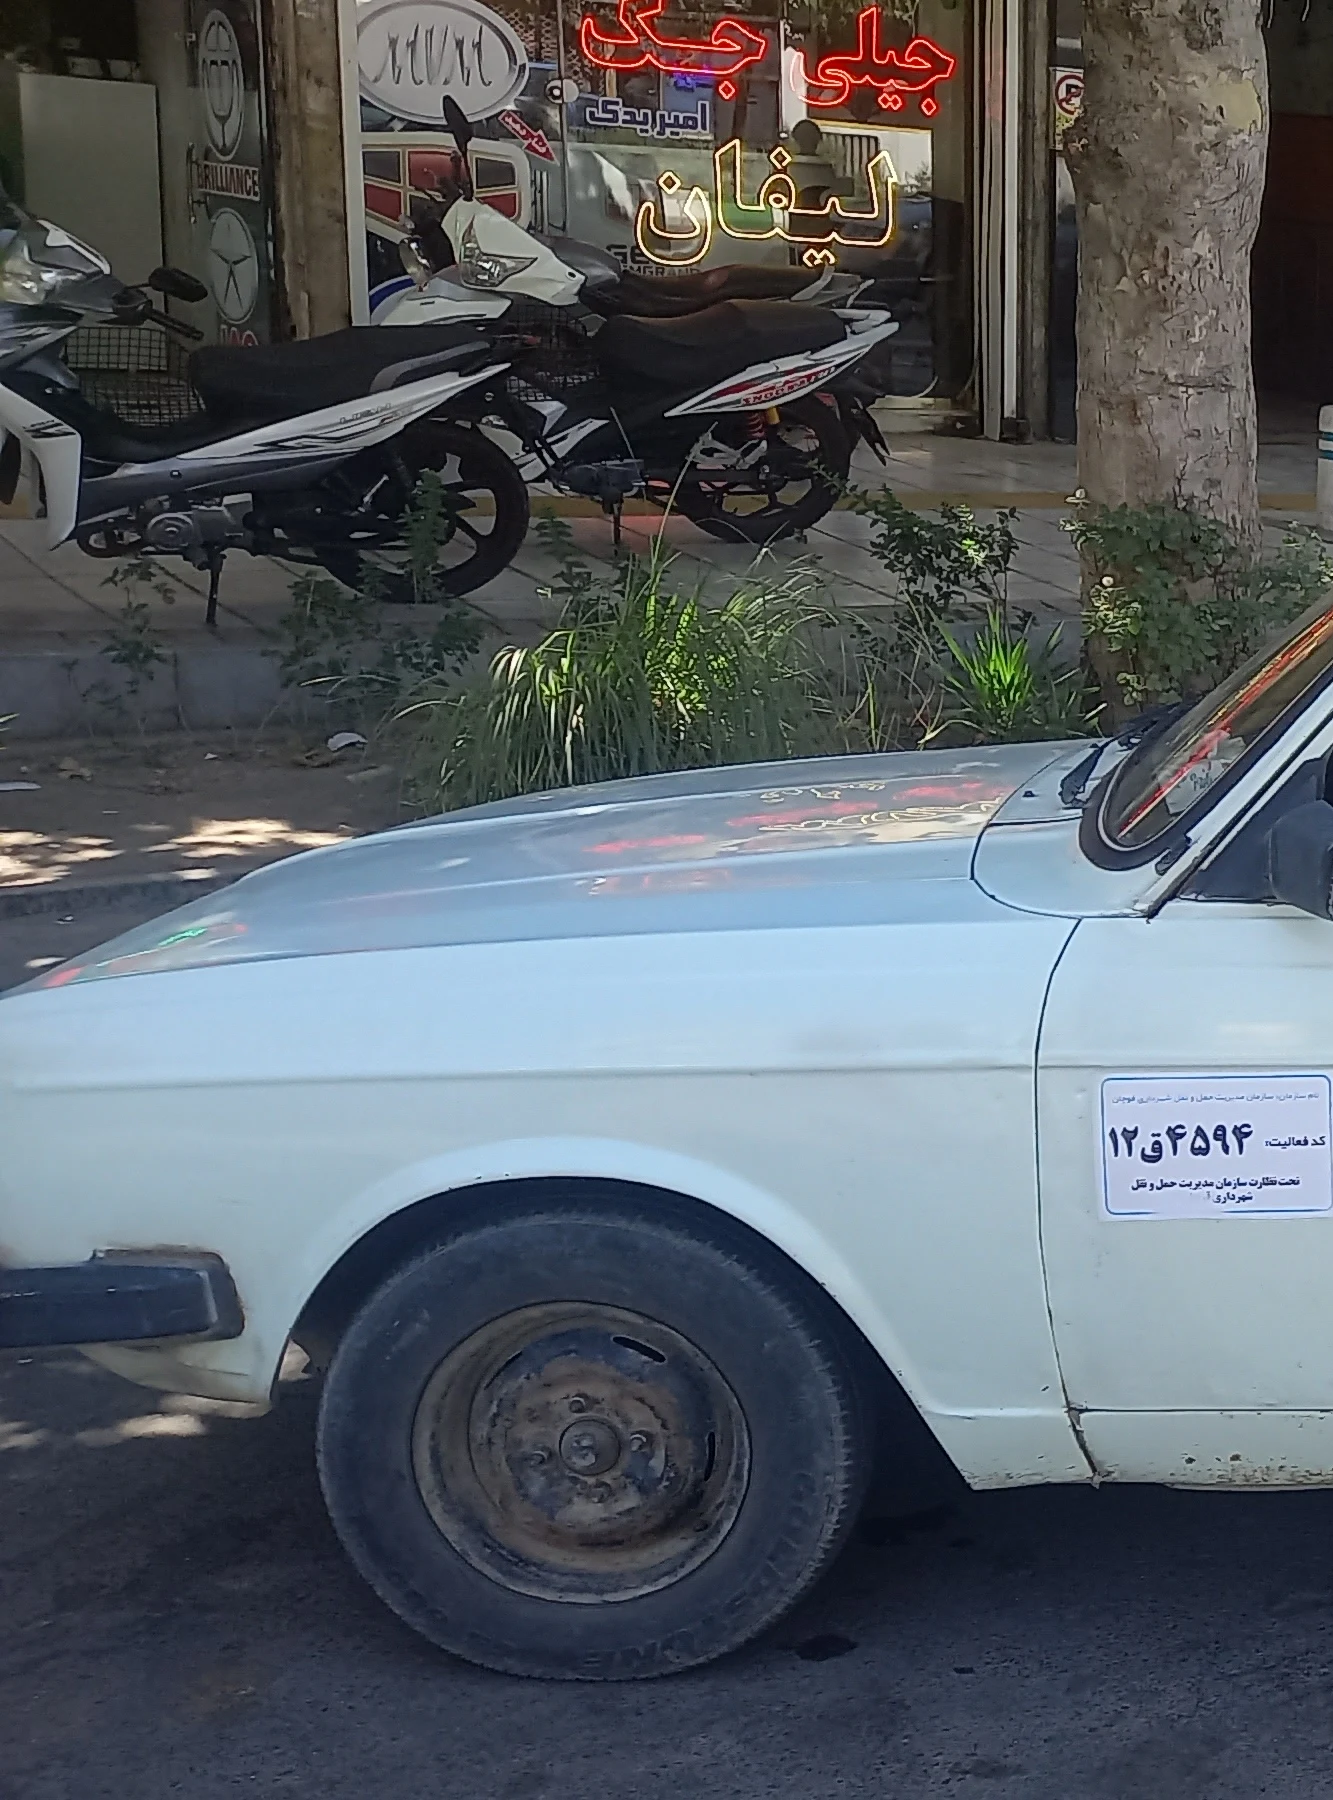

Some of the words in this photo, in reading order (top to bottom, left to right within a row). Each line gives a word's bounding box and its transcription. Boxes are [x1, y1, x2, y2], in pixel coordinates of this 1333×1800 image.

[372, 23, 492, 87] MVM
[789, 6, 955, 117] جیلی
[199, 163, 259, 198] BRILLIANCE
[635, 138, 899, 266] لیفان
[1310, 1136, 1327, 1147] کد
[1155, 1178, 1177, 1190] حمل
[1178, 1178, 1214, 1190] مدیریت
[1215, 1177, 1248, 1190] سازمان
[1248, 1175, 1278, 1190] نظارت
[1277, 1175, 1301, 1187] تحت
[1211, 1191, 1253, 1204] شهرداری
